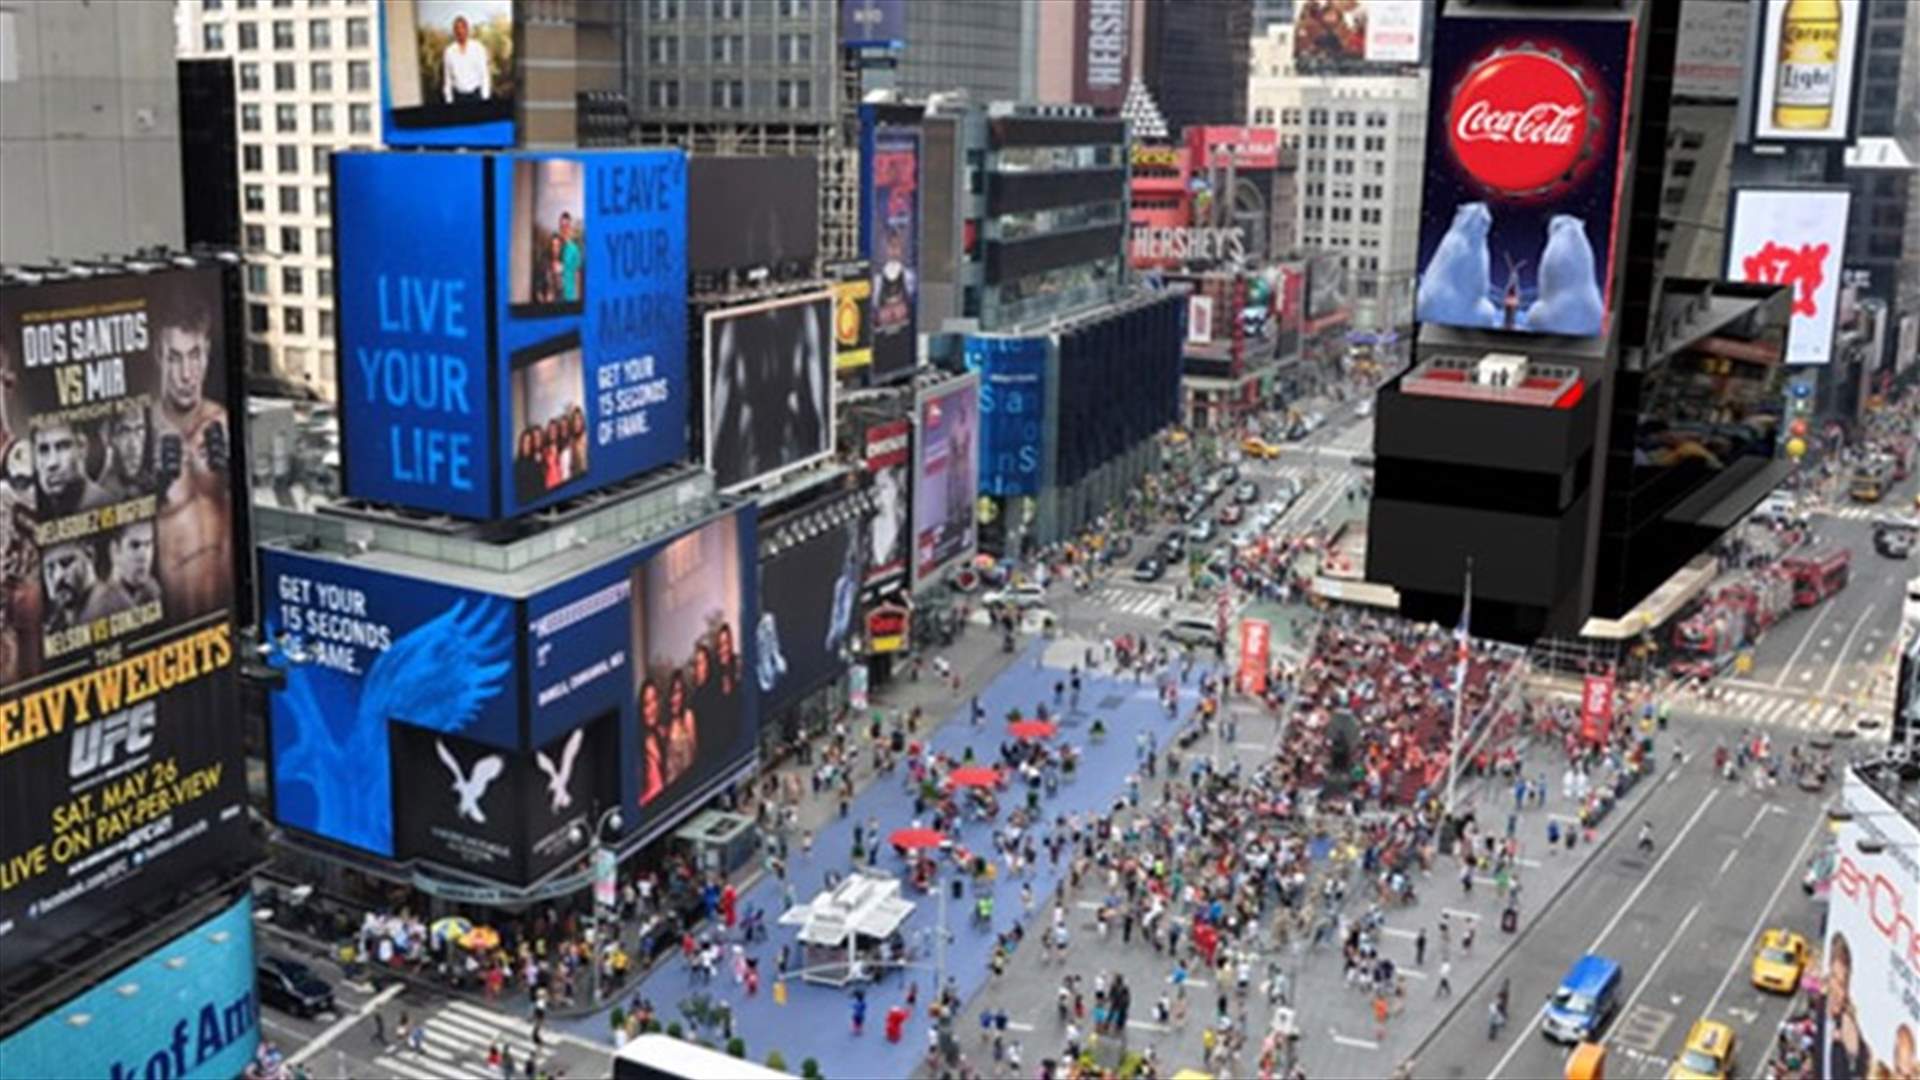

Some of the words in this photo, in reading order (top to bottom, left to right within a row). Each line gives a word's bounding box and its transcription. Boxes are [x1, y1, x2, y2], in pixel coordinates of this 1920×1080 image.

[1783, 64, 1831, 90] Light
[597, 165, 669, 215] LEAVE
[605, 228, 672, 282] YOUR
[1134, 226, 1246, 263] HERSHEY'S
[378, 276, 468, 338] LIVE
[23, 324, 67, 367] DOS
[70, 312, 148, 359] SANTOS
[55, 365, 84, 406] VS
[86, 357, 127, 401] MIR
[357, 348, 470, 414] YOUR
[598, 362, 620, 388] GET
[624, 355, 654, 382] YOUR
[599, 391, 614, 416] 15
[616, 377, 668, 413] SECONDS
[598, 419, 613, 446] OF
[391, 427, 473, 491] LIFE
[279, 574, 311, 604] GET
[315, 581, 367, 618] YOUR
[281, 604, 302, 632] 15
[306, 608, 392, 653] SECONDS
[69, 700, 157, 777] UFC
[52, 793, 96, 834] SAT.
[101, 767, 149, 806] MAY
[152, 757, 179, 788] 26
[0, 845, 47, 890] LIVE
[51, 824, 92, 862] ON
[96, 762, 222, 843] PAY-PER-VIEW
